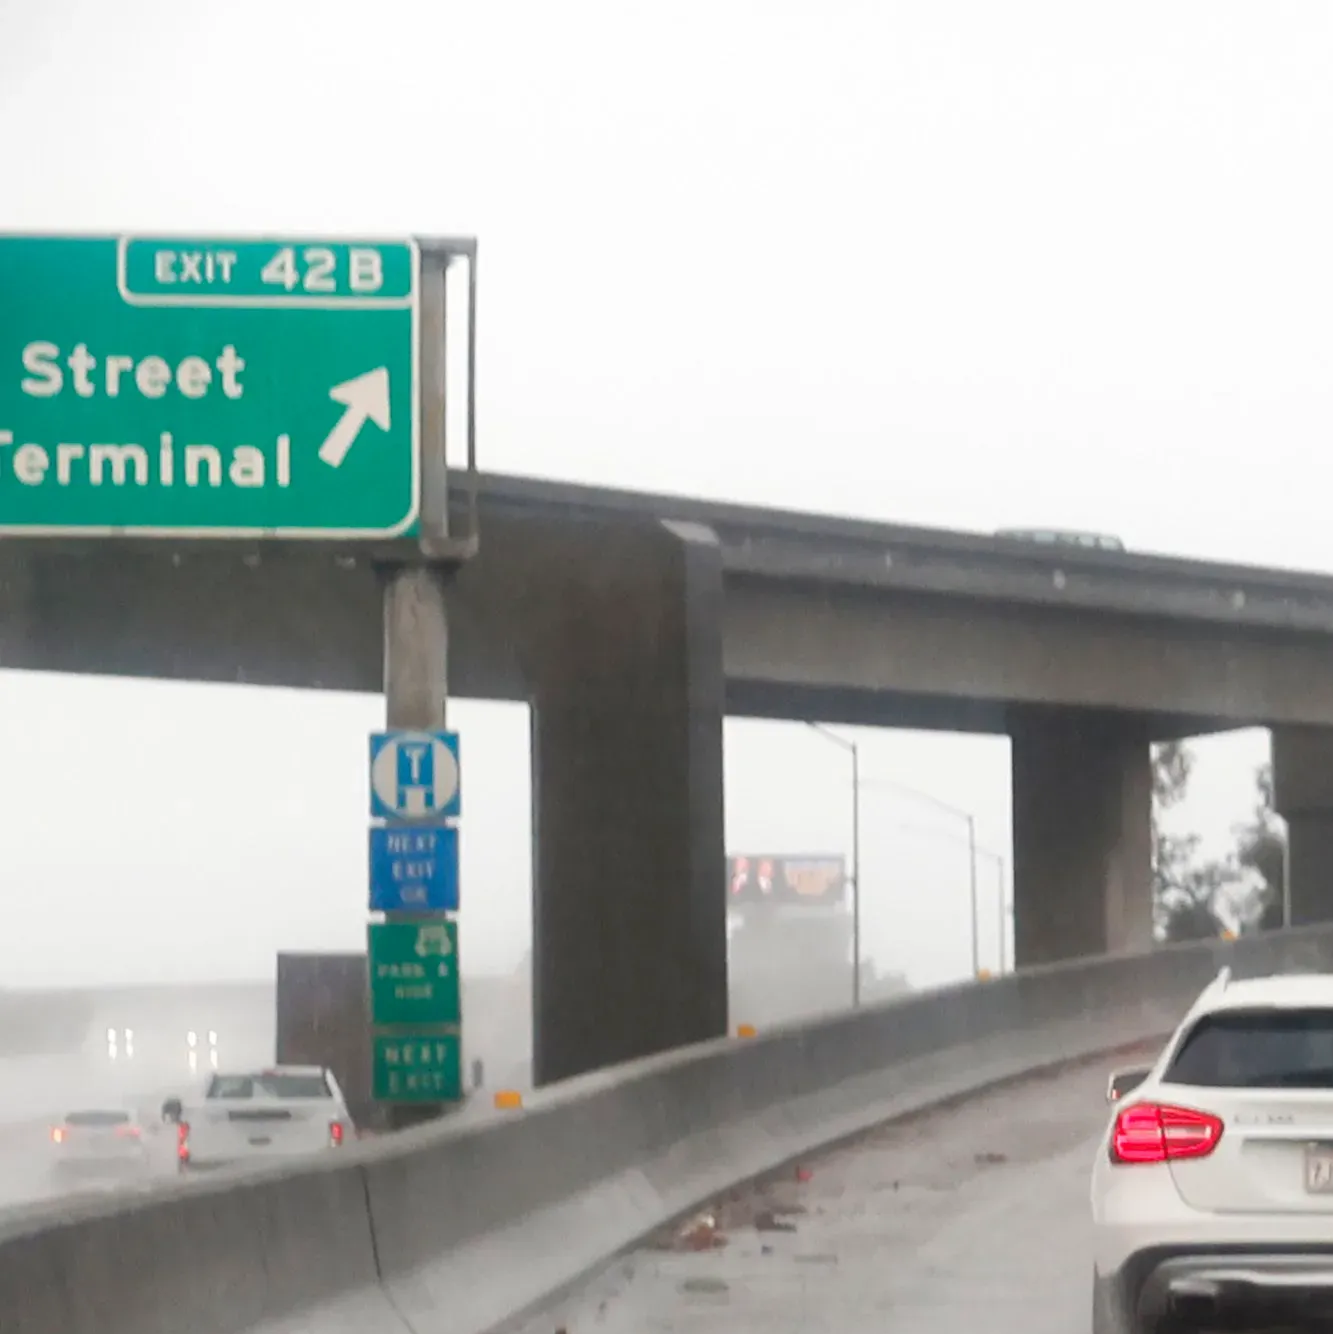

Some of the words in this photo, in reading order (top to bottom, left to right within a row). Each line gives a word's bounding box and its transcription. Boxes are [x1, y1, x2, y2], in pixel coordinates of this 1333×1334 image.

[155, 250, 237, 285] EXIT
[261, 247, 384, 292] 42B
[20, 340, 246, 399] Street
[0, 430, 291, 488] erminal
[385, 1043, 447, 1065] NEXT
